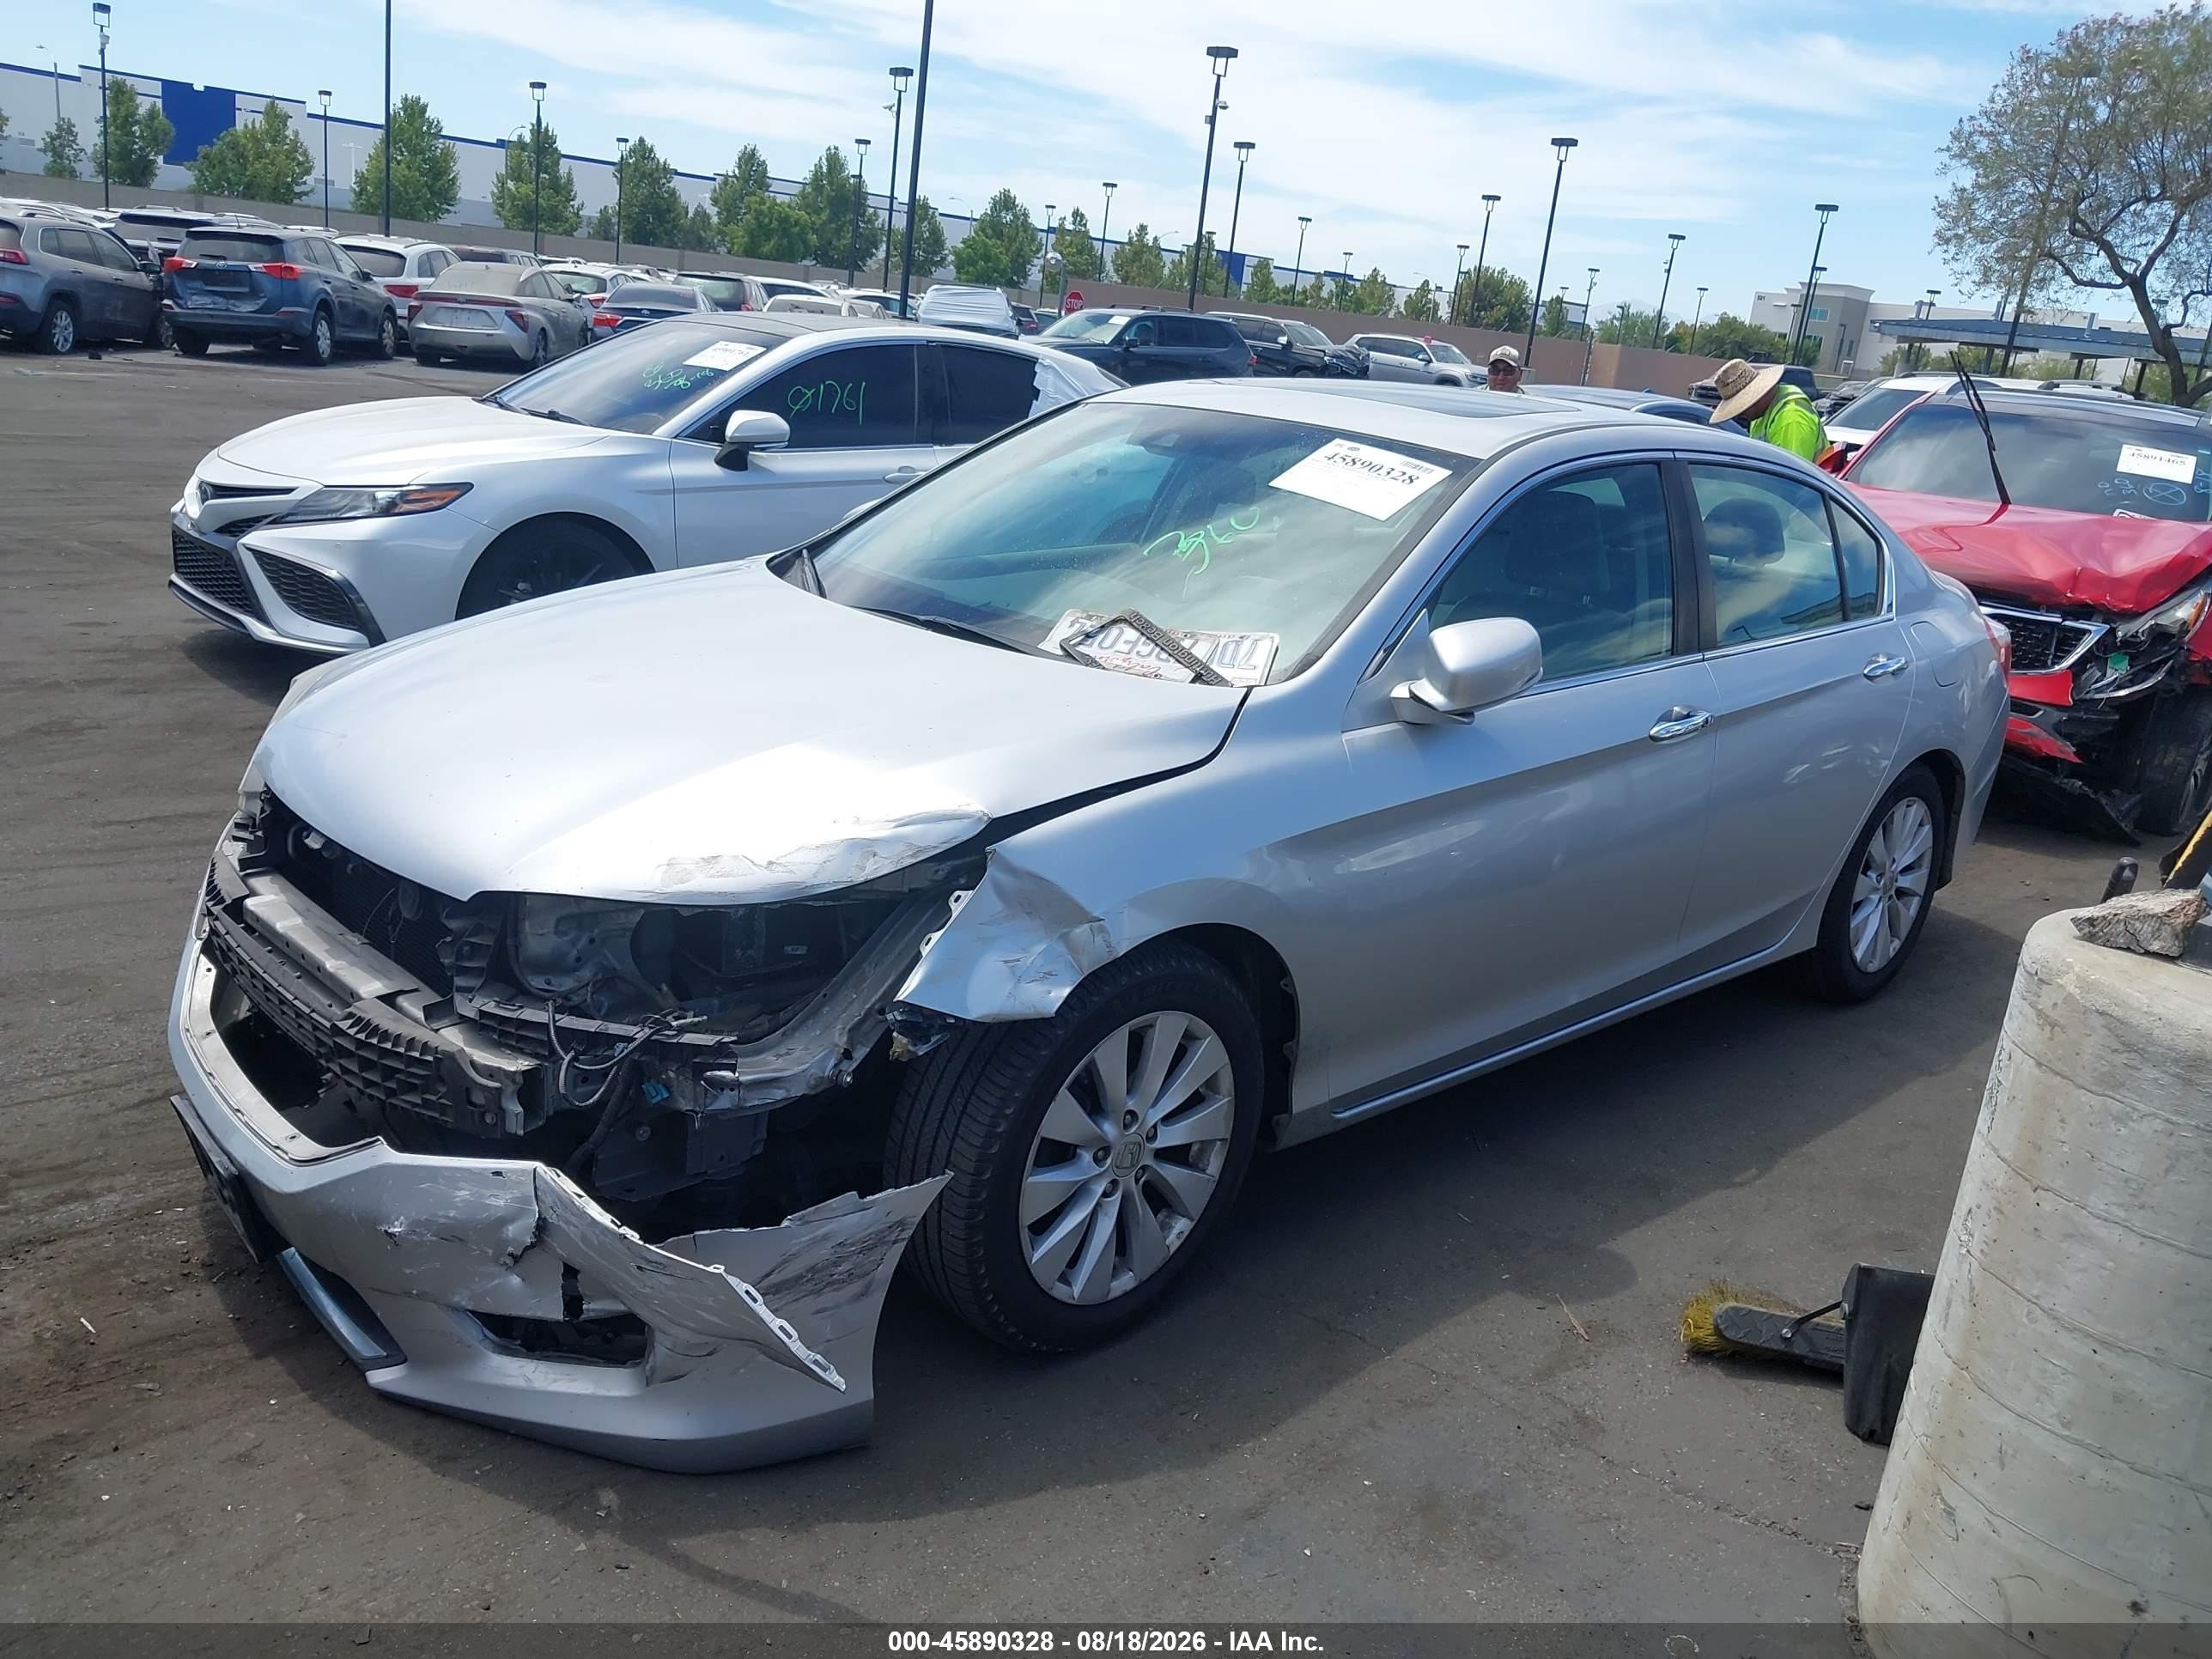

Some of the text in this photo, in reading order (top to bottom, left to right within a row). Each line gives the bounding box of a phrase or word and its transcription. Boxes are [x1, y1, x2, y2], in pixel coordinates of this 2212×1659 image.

[1066, 298, 1084, 310] STOP
[1323, 452, 1419, 485] 45890328
[1128, 611, 1224, 686] Huntington Beach
